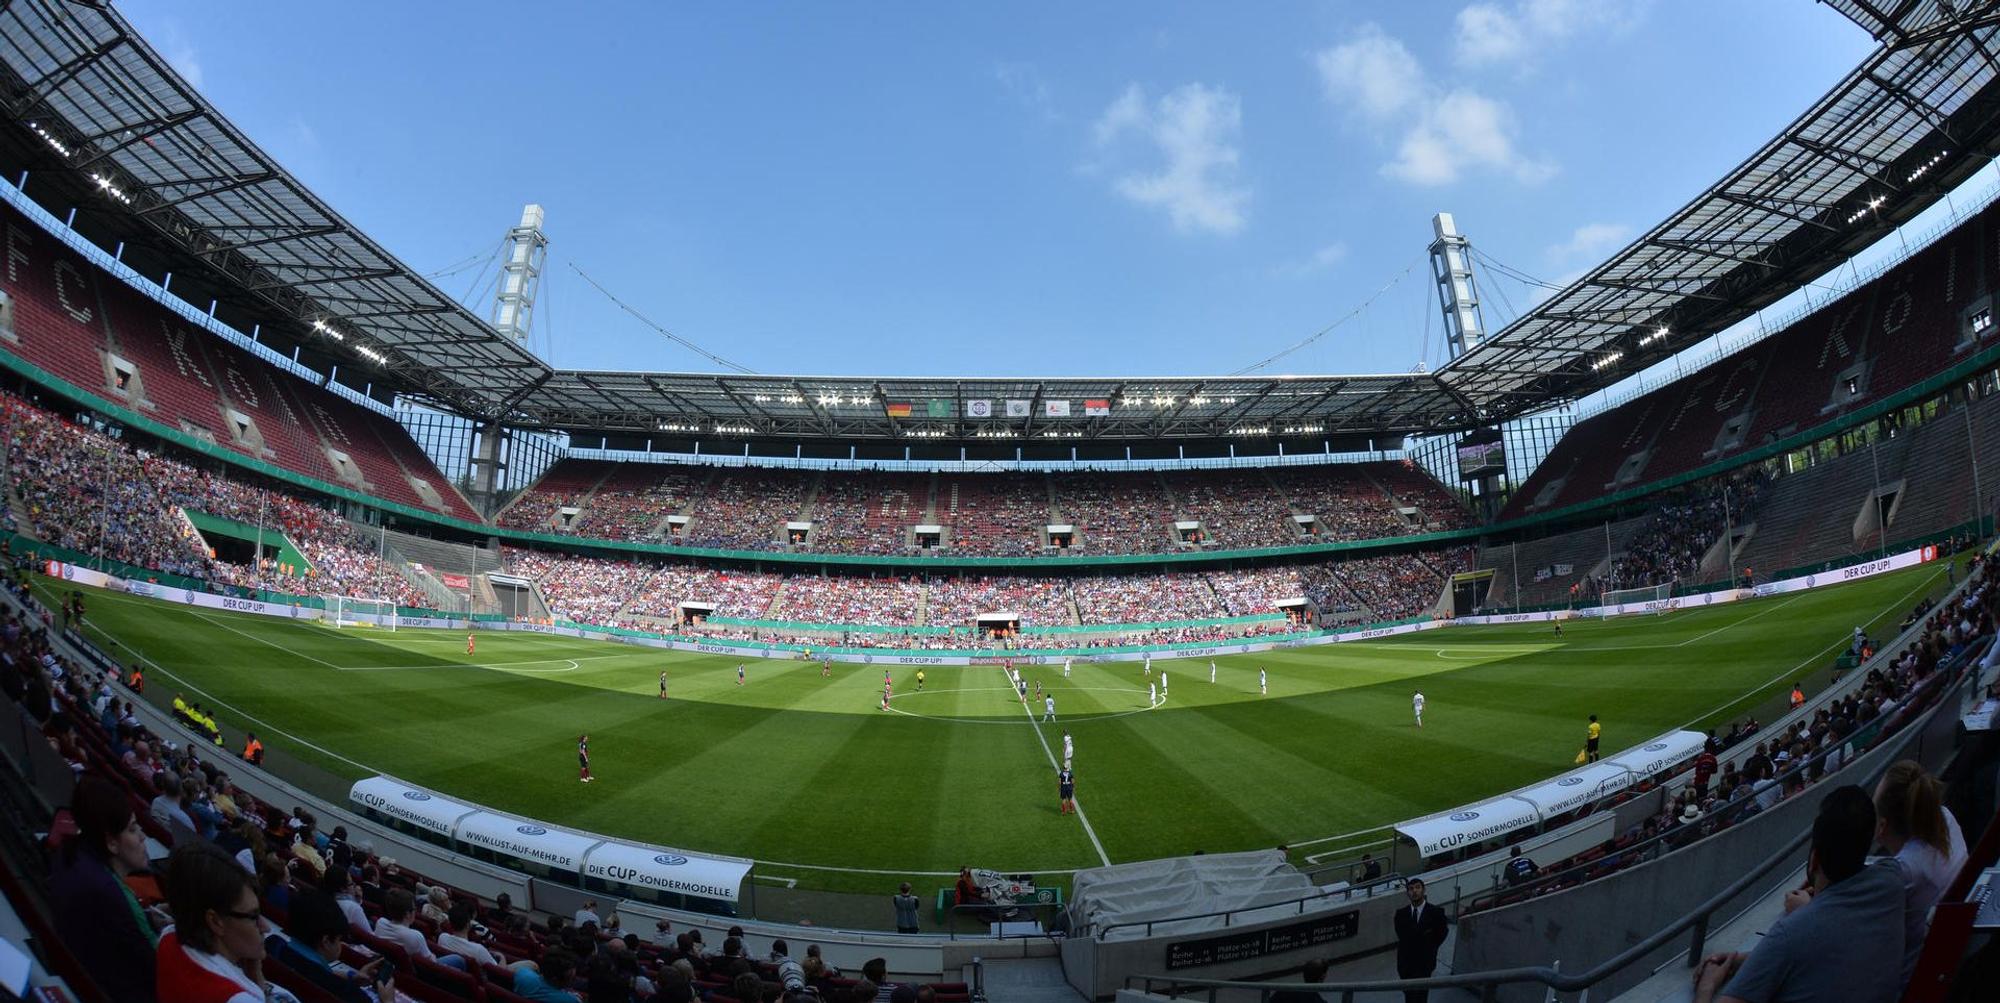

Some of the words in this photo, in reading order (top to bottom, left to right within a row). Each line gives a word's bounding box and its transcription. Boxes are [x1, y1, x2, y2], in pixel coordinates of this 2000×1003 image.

[1844, 567, 1859, 578] DER
[1860, 563, 1876, 576] CUP
[1877, 560, 1891, 572] UP!
[223, 599, 237, 608] DER
[238, 600, 252, 611] CUP
[253, 602, 265, 613] UP!
[1645, 602, 1657, 610] DER
[1646, 760, 1663, 774] CUP
[1664, 742, 1705, 766] SONDERMODELL
[352, 790, 364, 800] DIE
[365, 793, 386, 807] CUP
[466, 831, 571, 866] WWW.LUST-AUF-MEHR.DE
[1424, 843, 1439, 854] DIE
[1440, 833, 1464, 848] CUP
[589, 864, 605, 875] DIE
[607, 866, 637, 880] CUP
[639, 874, 733, 898] SONDERMODELLE.
[1172, 951, 1193, 960] Reihe
